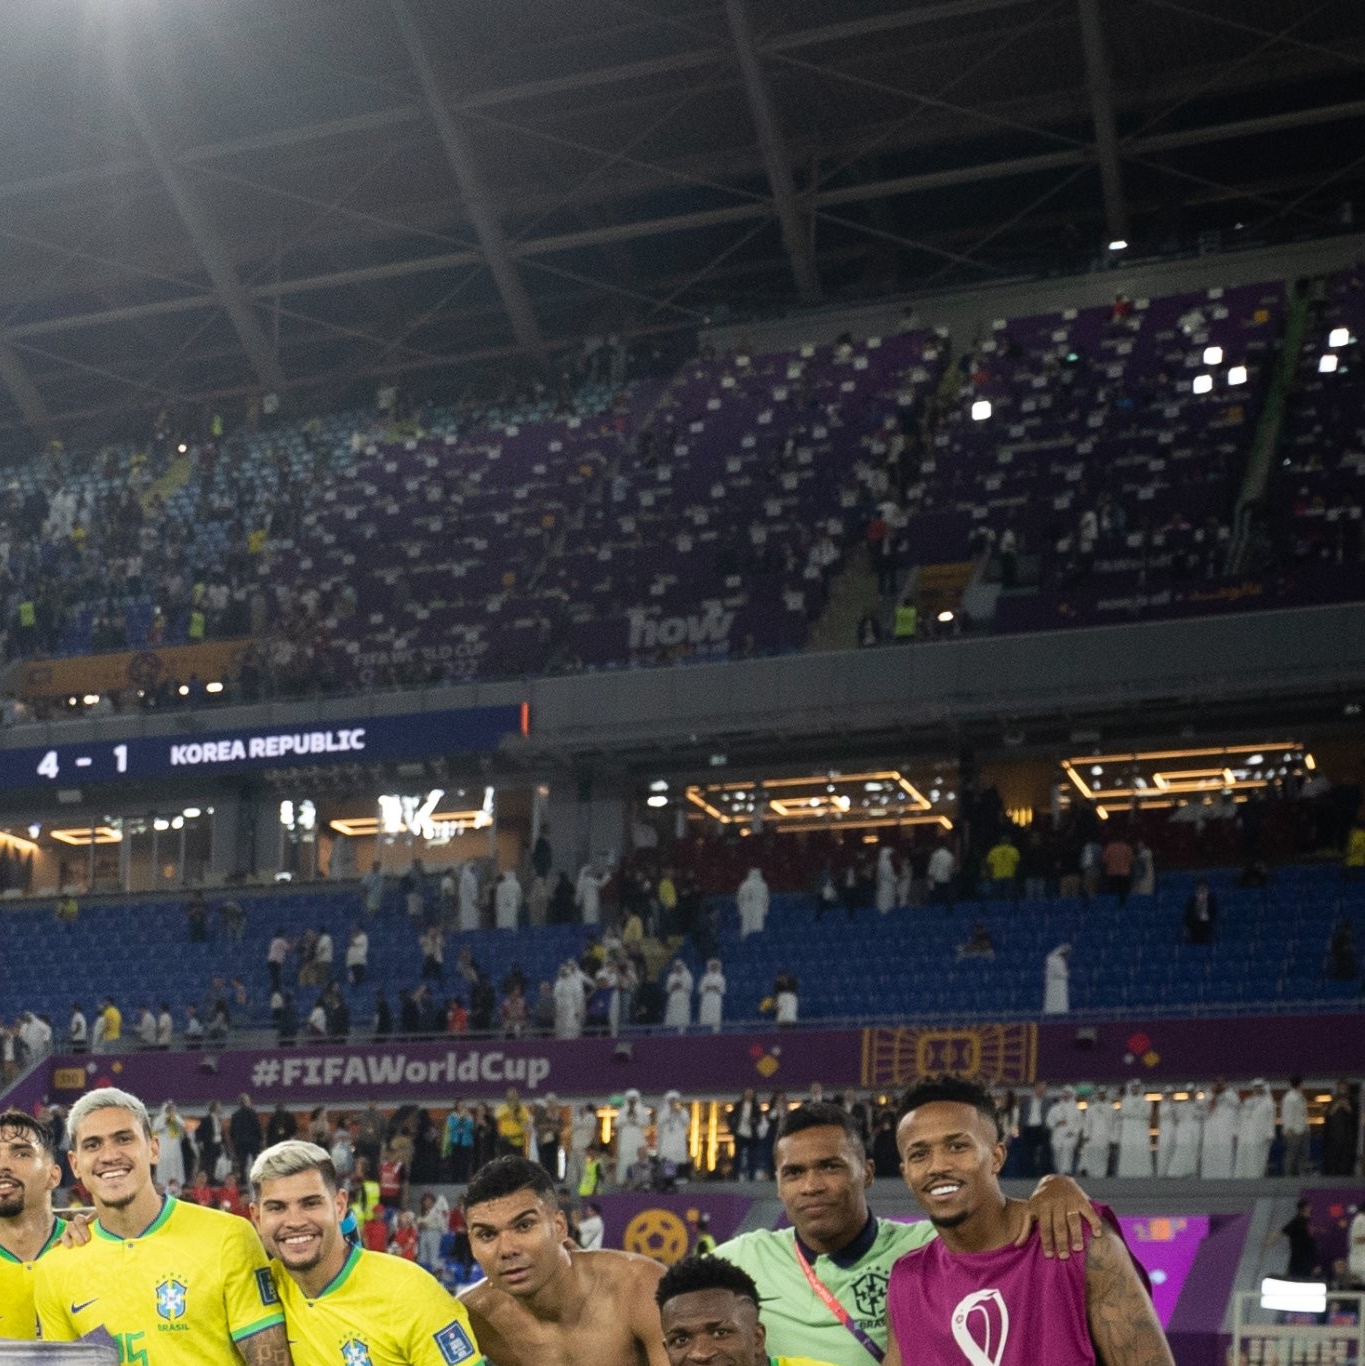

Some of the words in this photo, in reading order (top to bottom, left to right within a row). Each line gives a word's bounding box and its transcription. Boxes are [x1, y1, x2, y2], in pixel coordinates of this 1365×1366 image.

[37, 750, 59, 779] 4
[113, 745, 127, 773] 1
[170, 739, 246, 766] KOREA
[249, 728, 366, 758] REPUBLIC
[251, 1052, 551, 1088] #FIFAWorldCup
[157, 1323, 189, 1331] BRASIL
